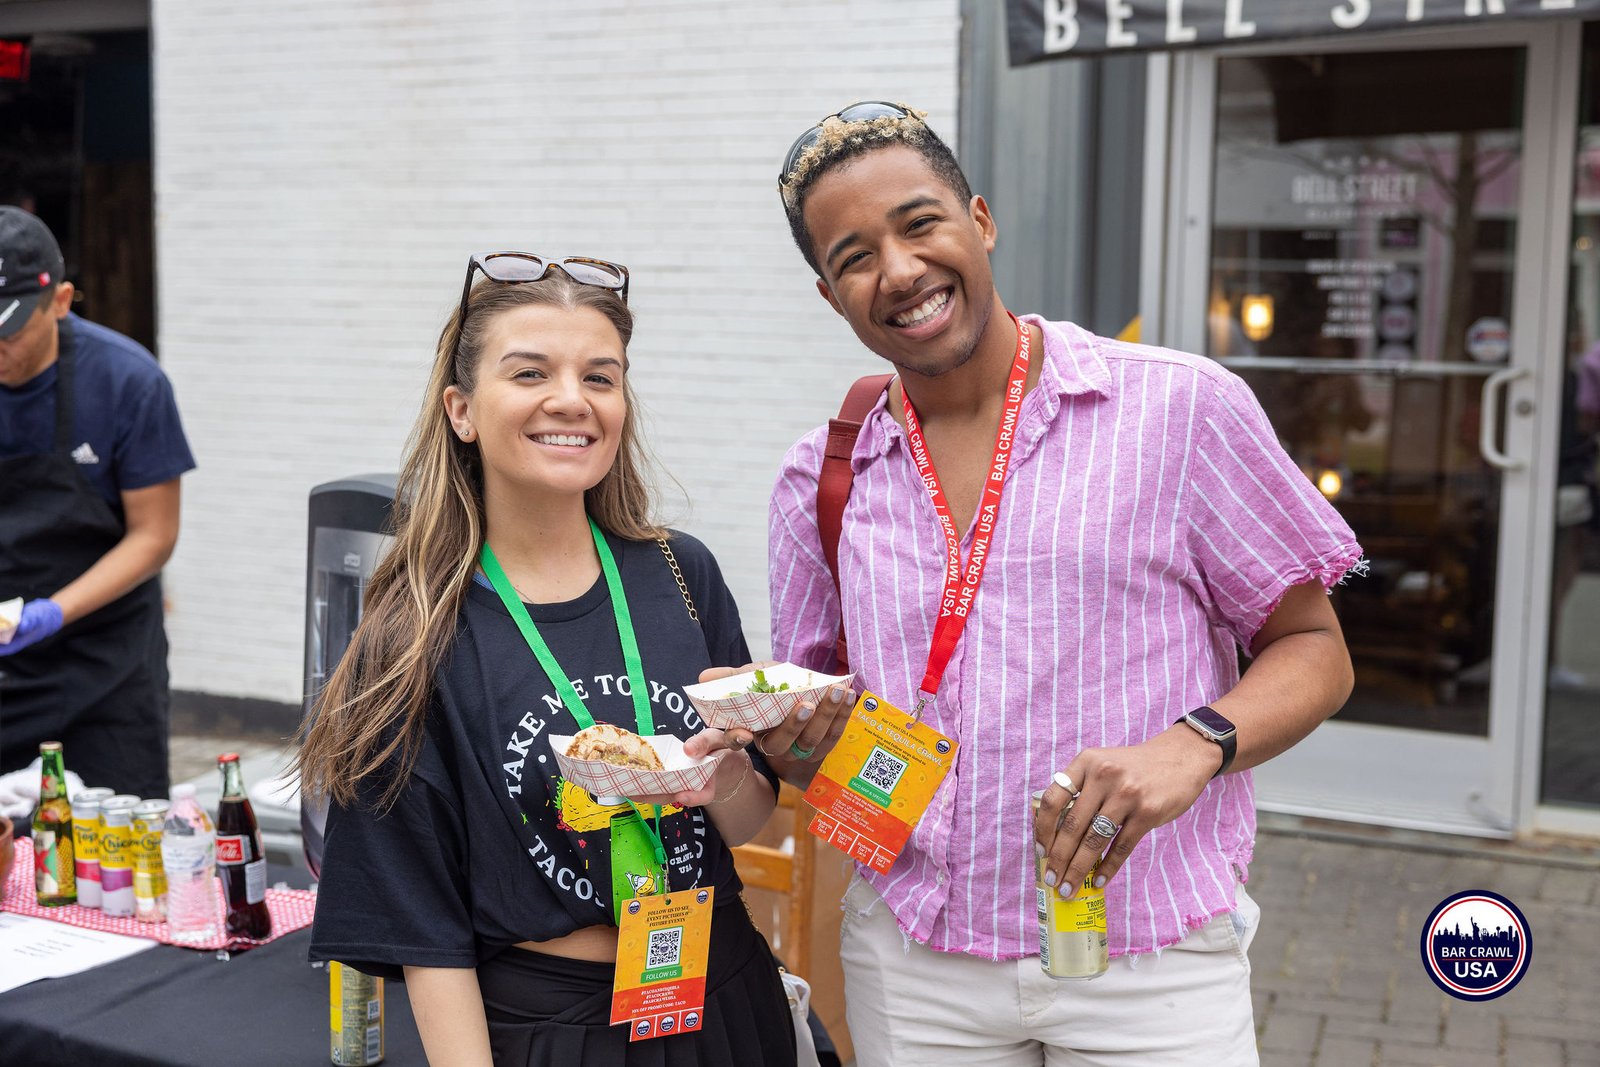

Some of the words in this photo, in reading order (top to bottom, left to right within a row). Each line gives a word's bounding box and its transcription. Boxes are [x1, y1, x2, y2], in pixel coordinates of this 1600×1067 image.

[1019, 336, 1030, 361] BAR
[1009, 379, 1024, 403] USA
[905, 408, 917, 436] BAR
[998, 403, 1019, 450] CRAWL
[910, 433, 929, 474] CRAWL
[991, 453, 1008, 482] BAR
[922, 472, 939, 499] USA
[938, 515, 955, 536] BAR
[947, 538, 958, 585] CRAWL
[955, 587, 975, 617] BAR
[966, 536, 989, 585] CRAWL
[979, 504, 996, 533] USA
[940, 588, 957, 617] USA
[503, 711, 546, 799] TAKE
[542, 679, 589, 715] ME
[594, 674, 633, 697] TO
[649, 680, 706, 732] YOU
[856, 711, 876, 726] TACO
[876, 723, 883, 731] &
[884, 728, 915, 750] TEQUILA
[916, 746, 944, 766] CRAWL
[75, 825, 98, 844] Top
[669, 852, 694, 866] CRAWL
[674, 843, 688, 855] BAR
[678, 864, 693, 874] USA
[646, 972, 669, 981] FOLLOW
